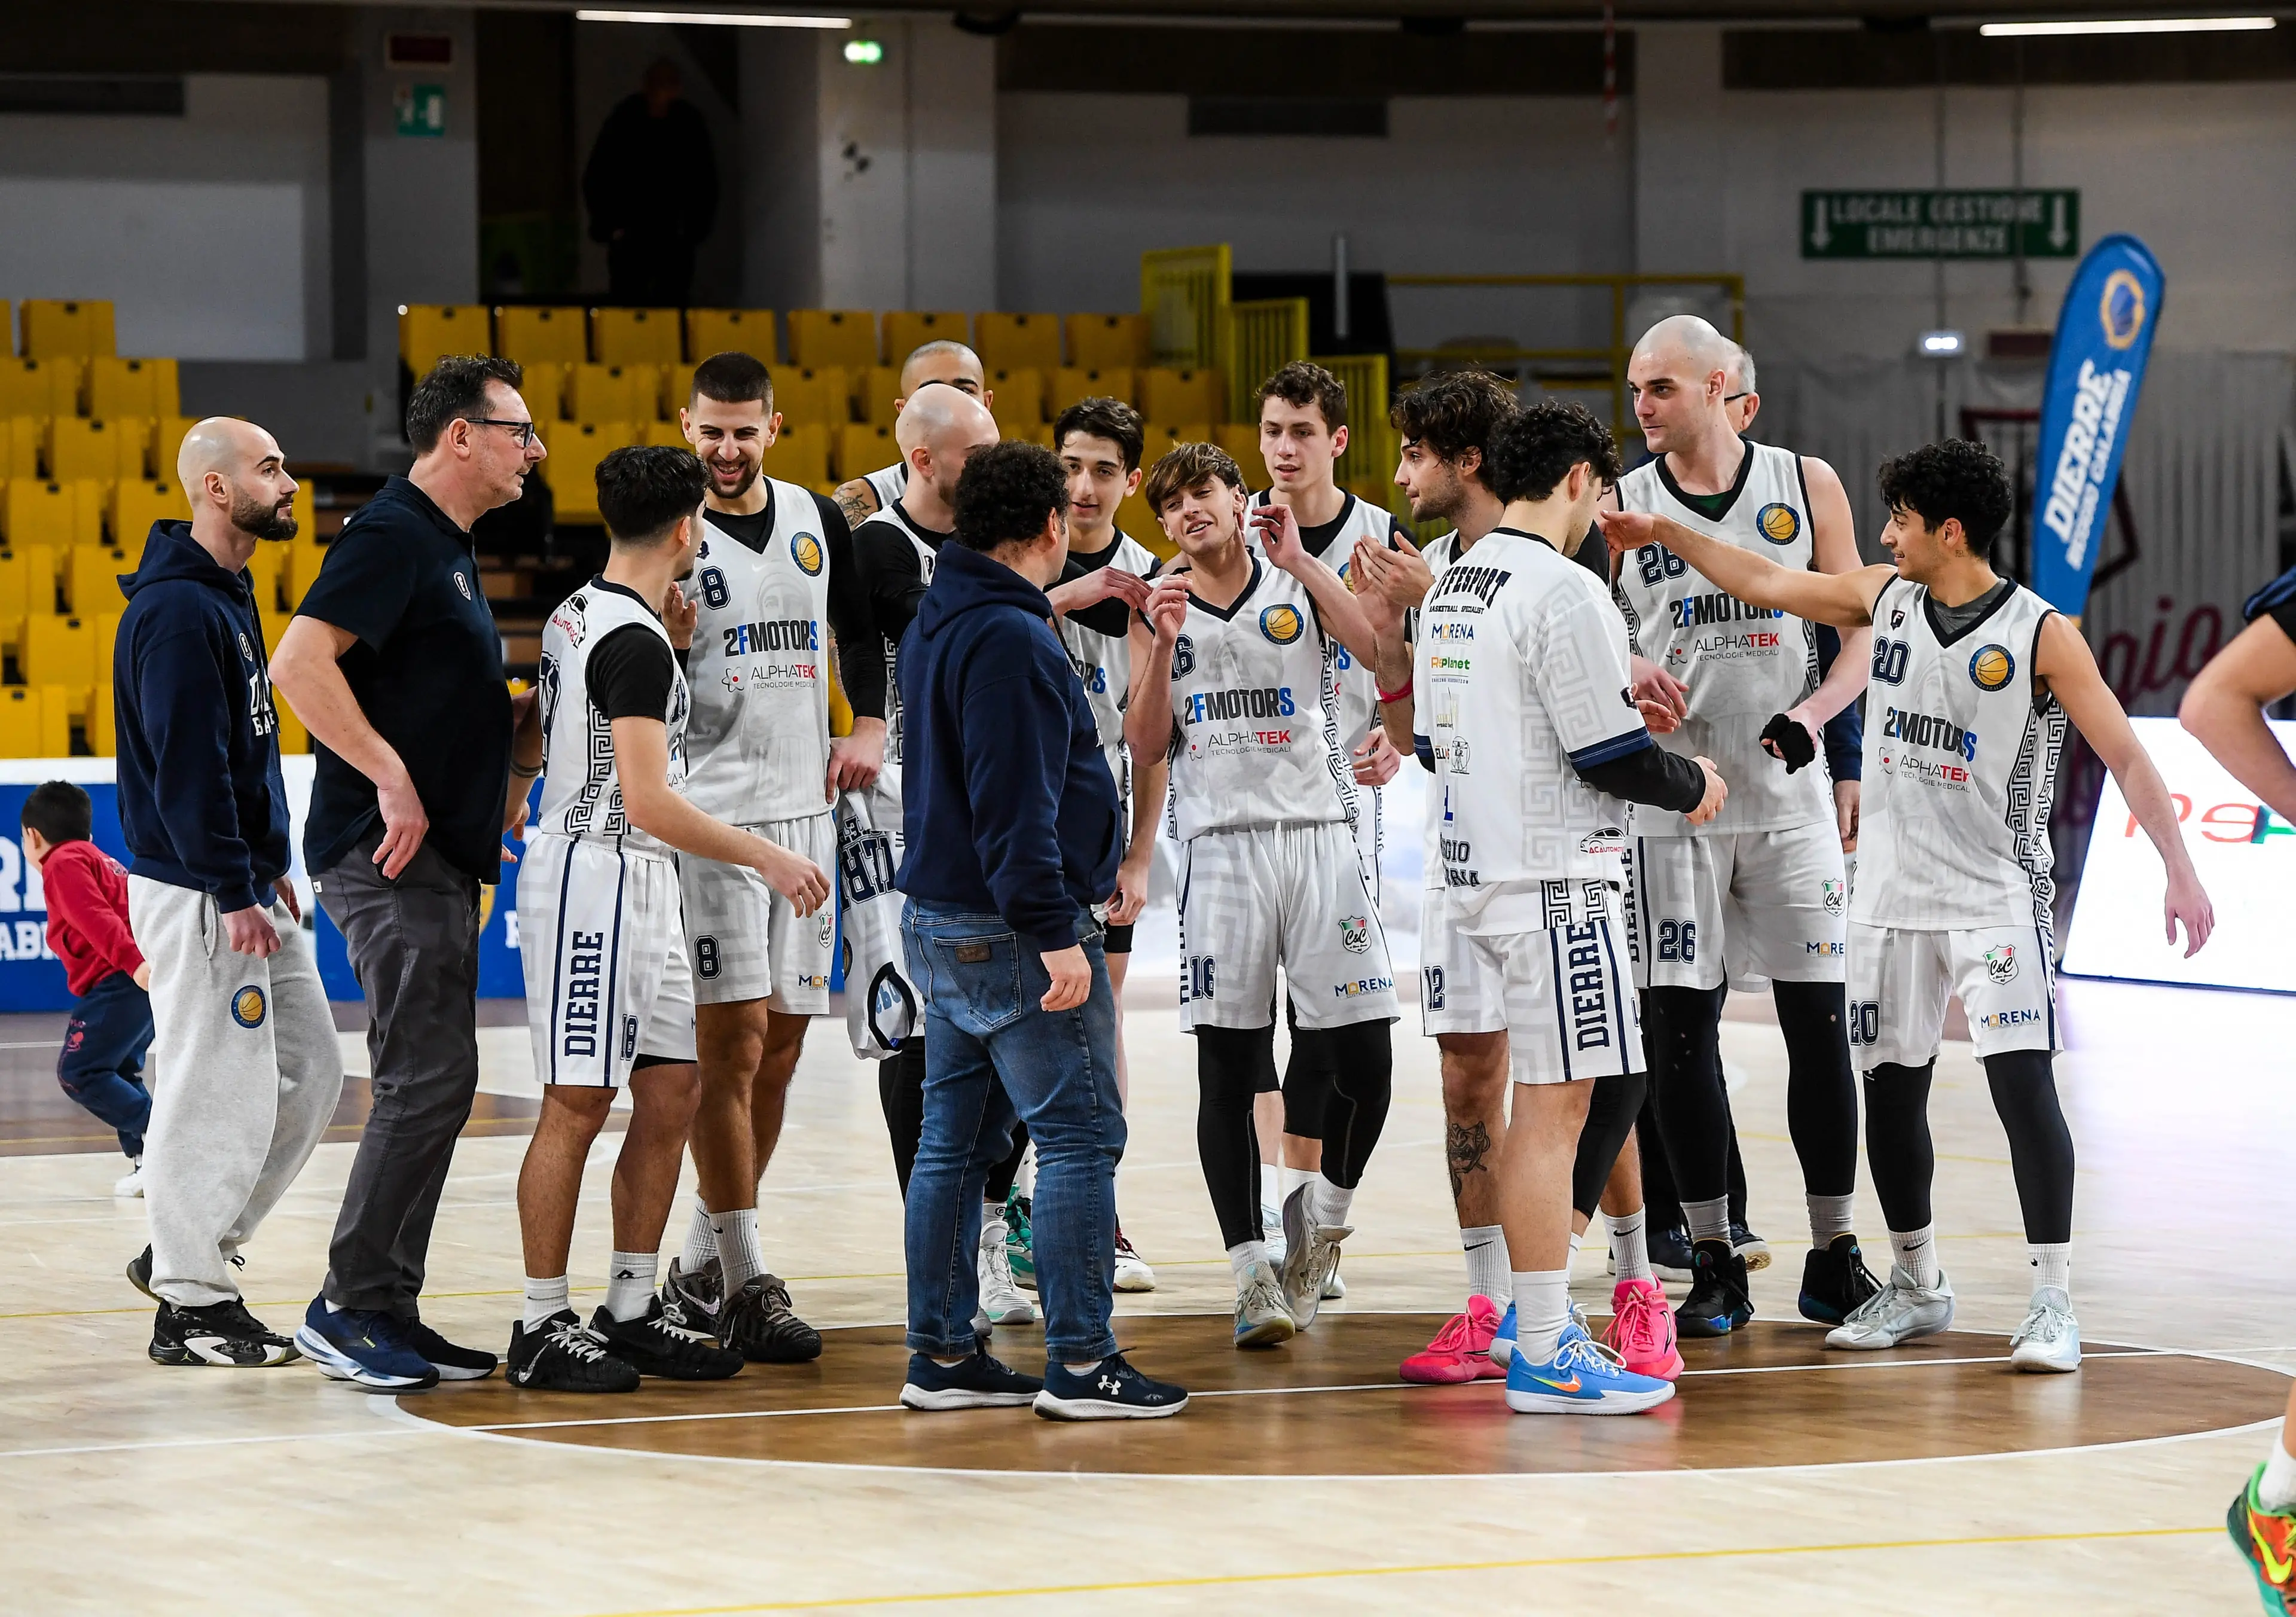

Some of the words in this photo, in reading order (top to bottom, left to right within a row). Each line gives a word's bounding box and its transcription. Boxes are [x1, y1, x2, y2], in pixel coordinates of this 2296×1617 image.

[2043, 358, 2106, 544] DIERRE
[1634, 541, 1689, 587] 26
[698, 565, 731, 611] 8
[723, 620, 819, 657] 2FMOTORS
[1694, 633, 1779, 653] ALPHATEK
[1696, 651, 1744, 661] TECNOLOGIE
[751, 664, 816, 681] ALPHATEK
[1871, 636, 1911, 687] 20
[1184, 687, 1295, 726] 2FMOTORS
[1208, 730, 1292, 748] ALPHATEK
[1211, 746, 1257, 756] TECNOLOGIE
[694, 934, 722, 980] 8
[1657, 919, 1696, 963] 26
[564, 930, 604, 1057] DIERRE
[1190, 955, 1216, 1000] 16
[1423, 965, 1445, 1012] 12
[1566, 922, 1610, 1051] DIERRE
[1849, 1000, 1879, 1045] 20
